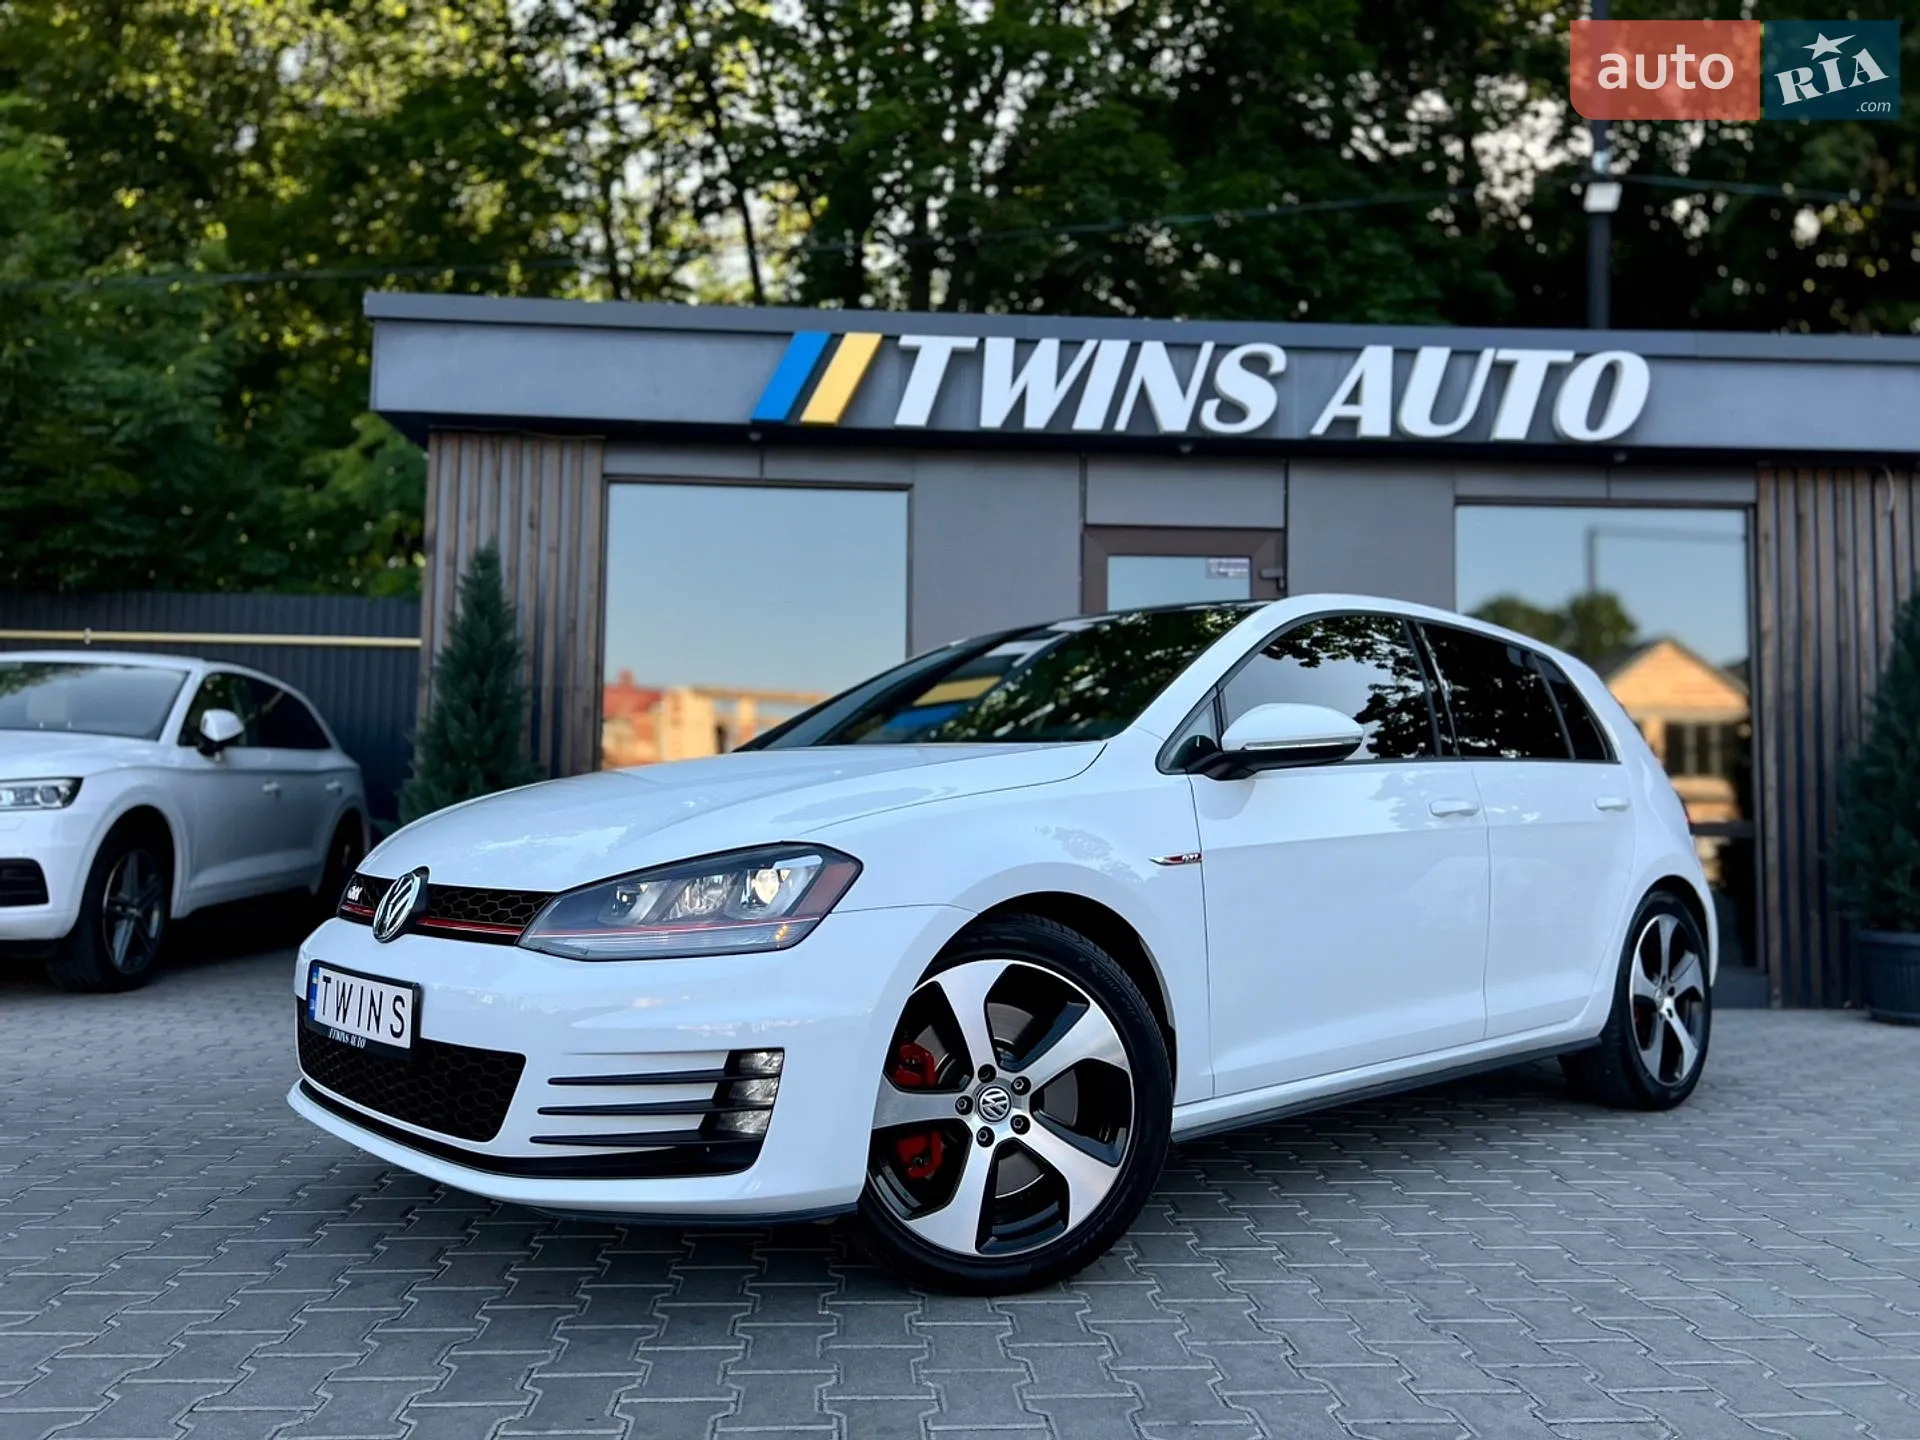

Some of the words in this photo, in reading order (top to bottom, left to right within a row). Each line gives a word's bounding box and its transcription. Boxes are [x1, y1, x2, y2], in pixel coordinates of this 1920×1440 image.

[893, 333, 1287, 435] TWINS
[1310, 344, 1652, 442] AUTO
[321, 974, 406, 1040] TWINS
